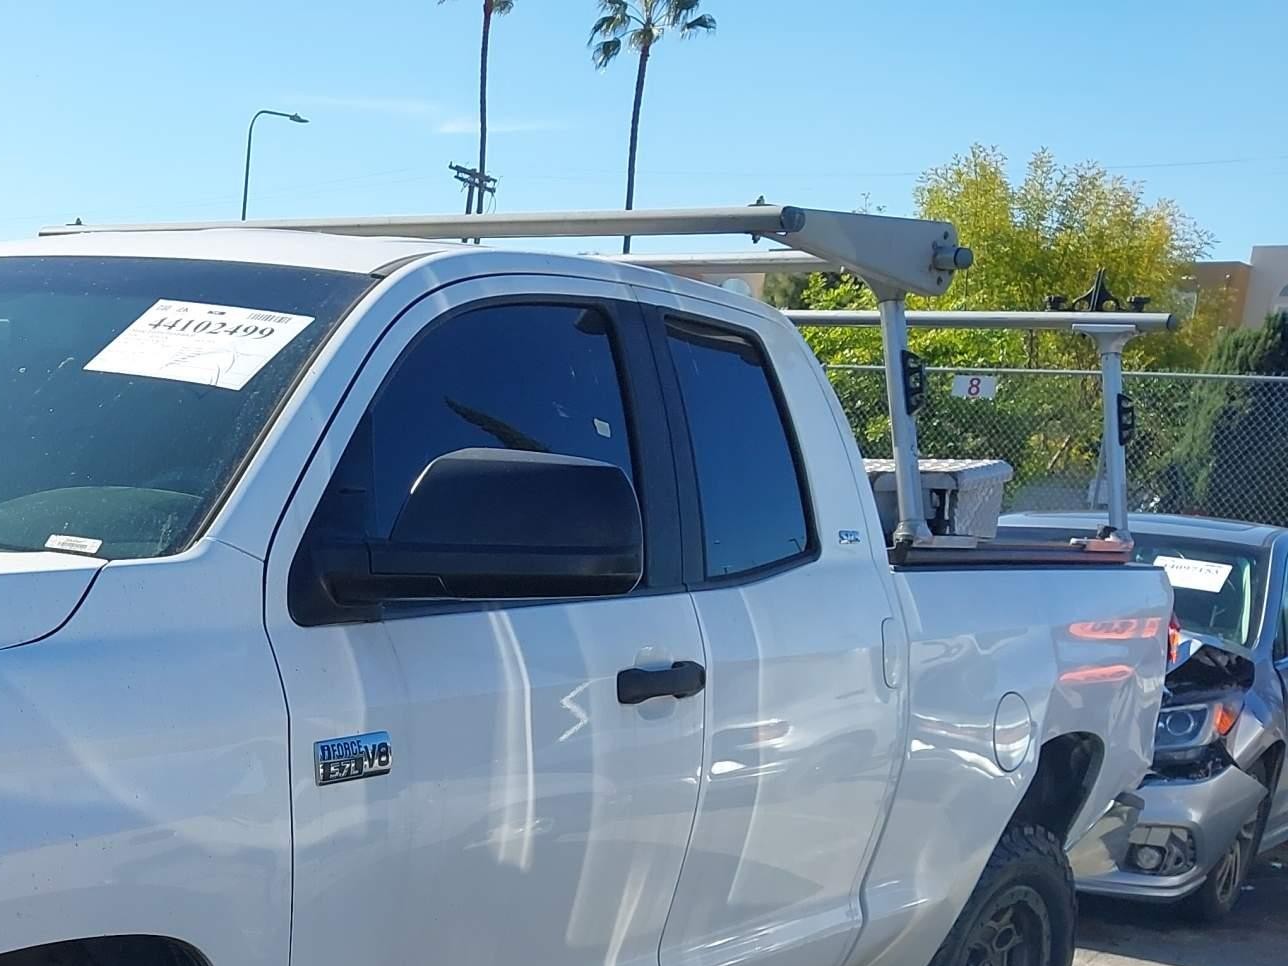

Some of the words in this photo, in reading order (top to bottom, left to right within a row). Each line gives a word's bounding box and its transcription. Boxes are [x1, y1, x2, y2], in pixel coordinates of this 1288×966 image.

[148, 317, 275, 340] 44102499
[968, 377, 981, 396] 8
[364, 741, 391, 769] V8
